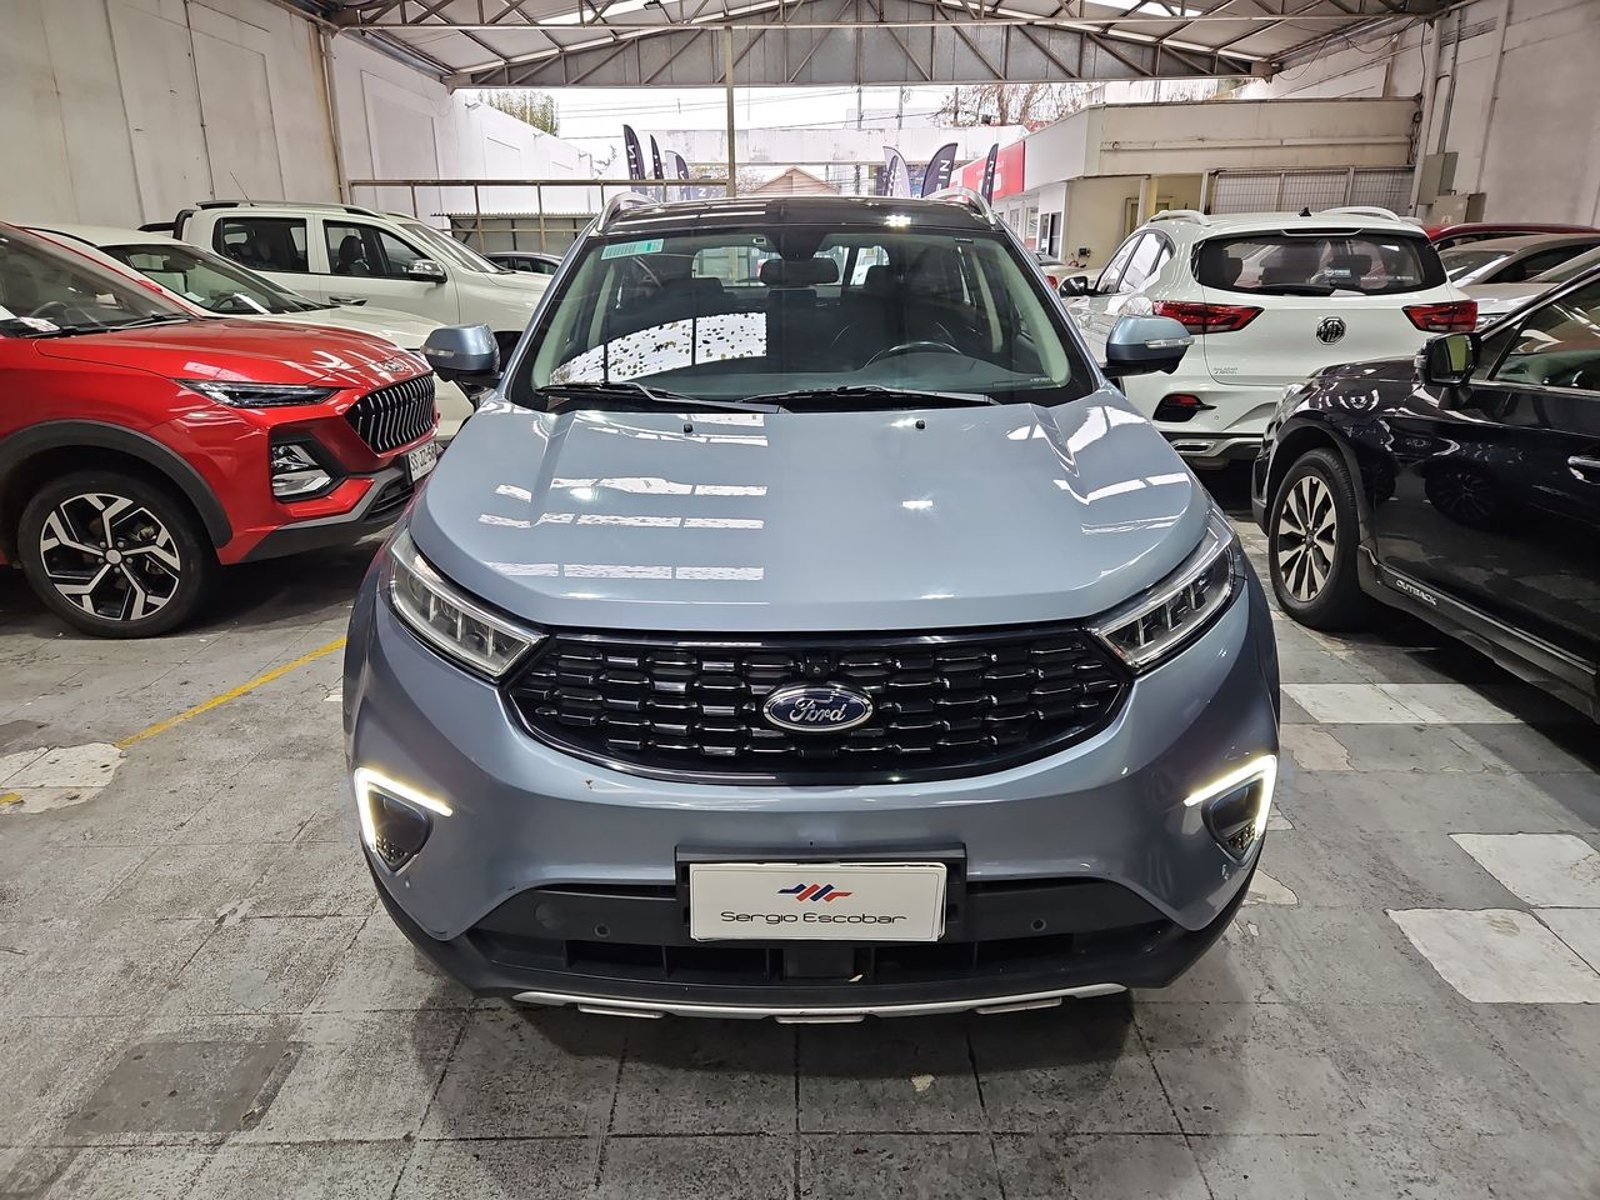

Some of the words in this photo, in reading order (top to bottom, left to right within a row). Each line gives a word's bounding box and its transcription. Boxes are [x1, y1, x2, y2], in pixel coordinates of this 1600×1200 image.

[1395, 579, 1437, 606] OUTBACK
[789, 697, 848, 722] Ford
[720, 911, 799, 925] Sergio
[803, 912, 907, 925] Escobar
